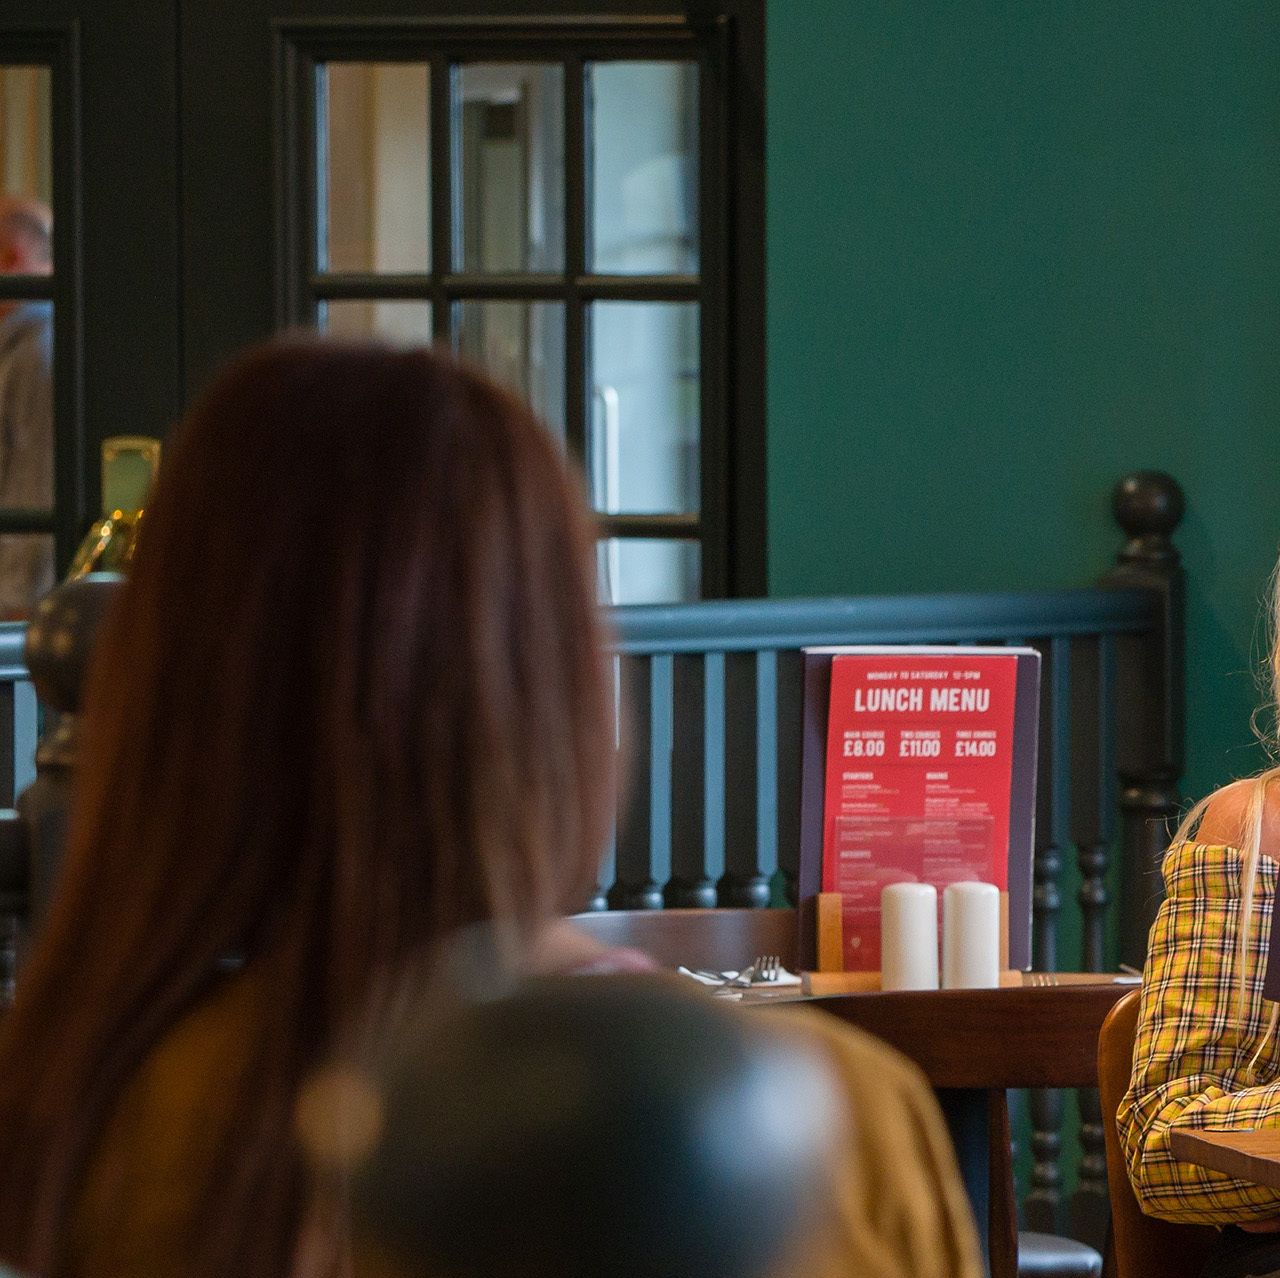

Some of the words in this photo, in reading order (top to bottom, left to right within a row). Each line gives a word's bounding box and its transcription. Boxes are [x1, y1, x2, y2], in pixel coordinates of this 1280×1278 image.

[910, 671, 949, 680] SATURDAY
[854, 687, 923, 712] LUNCH
[930, 687, 990, 712] MENU
[843, 740, 885, 757] £8.00
[899, 740, 941, 757] £11.00
[955, 740, 997, 757] £14.00
